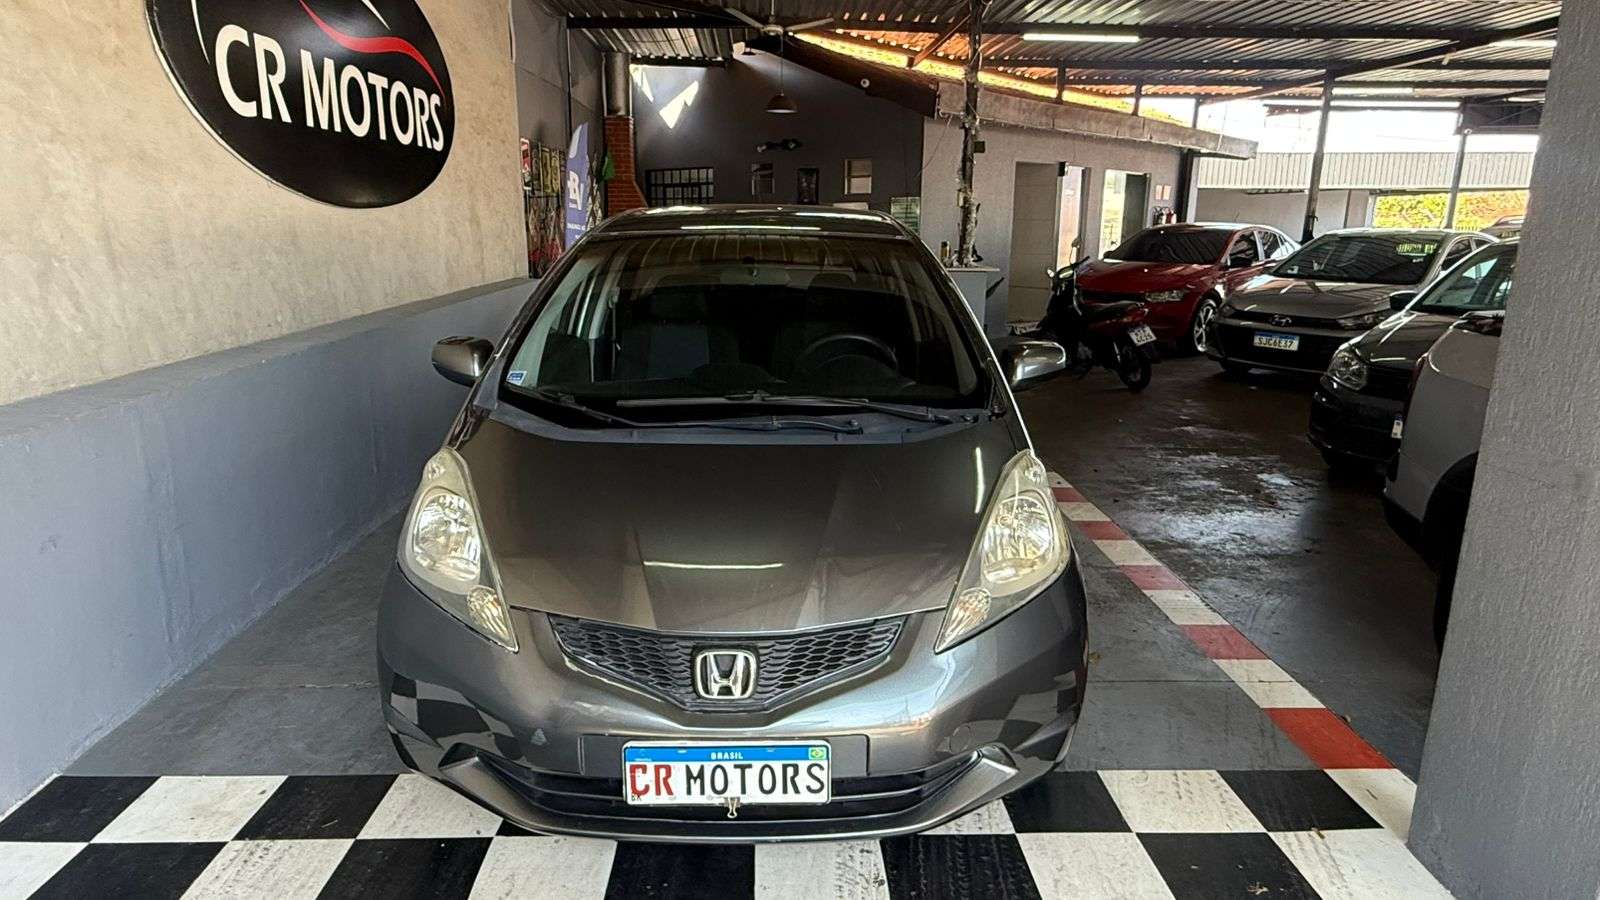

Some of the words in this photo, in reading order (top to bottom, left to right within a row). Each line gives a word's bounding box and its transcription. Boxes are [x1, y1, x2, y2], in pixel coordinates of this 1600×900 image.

[215, 24, 292, 123] CR
[300, 48, 444, 152] MOTORS
[710, 751, 744, 761] BRASIL
[629, 763, 674, 797] CR
[685, 763, 825, 796] MOTORS
